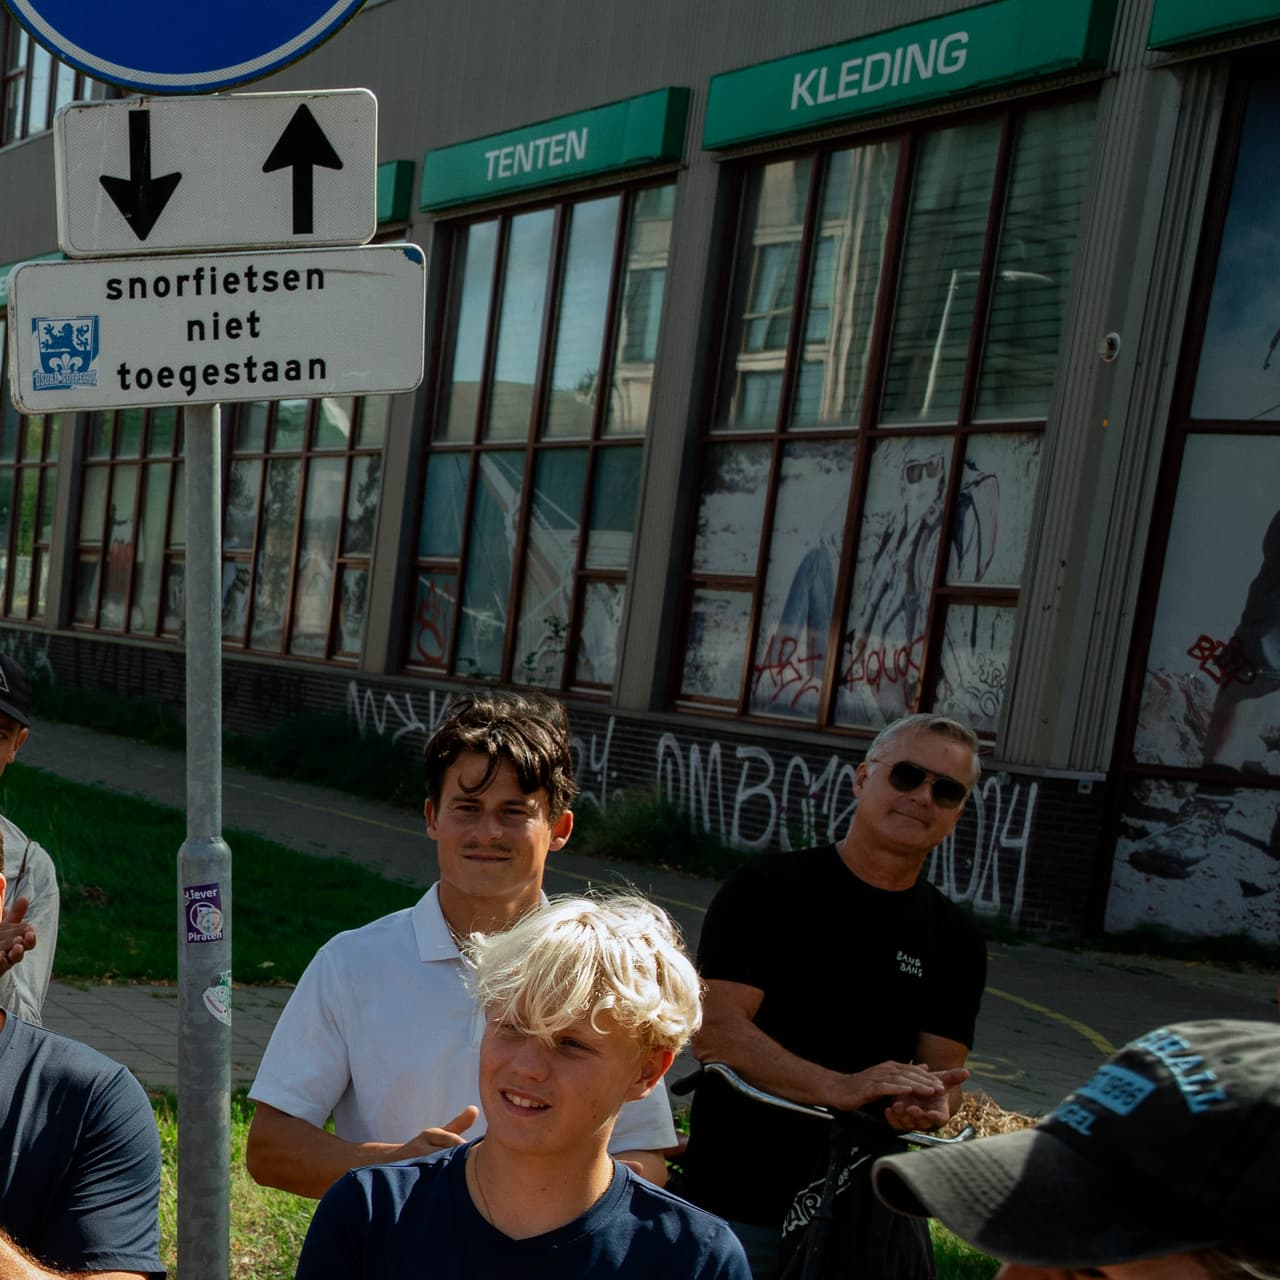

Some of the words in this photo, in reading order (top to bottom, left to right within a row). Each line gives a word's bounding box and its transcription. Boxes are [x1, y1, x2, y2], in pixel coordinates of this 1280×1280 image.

[790, 31, 969, 110] KLEDING
[484, 127, 589, 181] TENTEN
[105, 264, 325, 300] snorfietsen
[187, 310, 261, 341] niet
[117, 355, 327, 396] toegestaan
[896, 950, 921, 967] BANG
